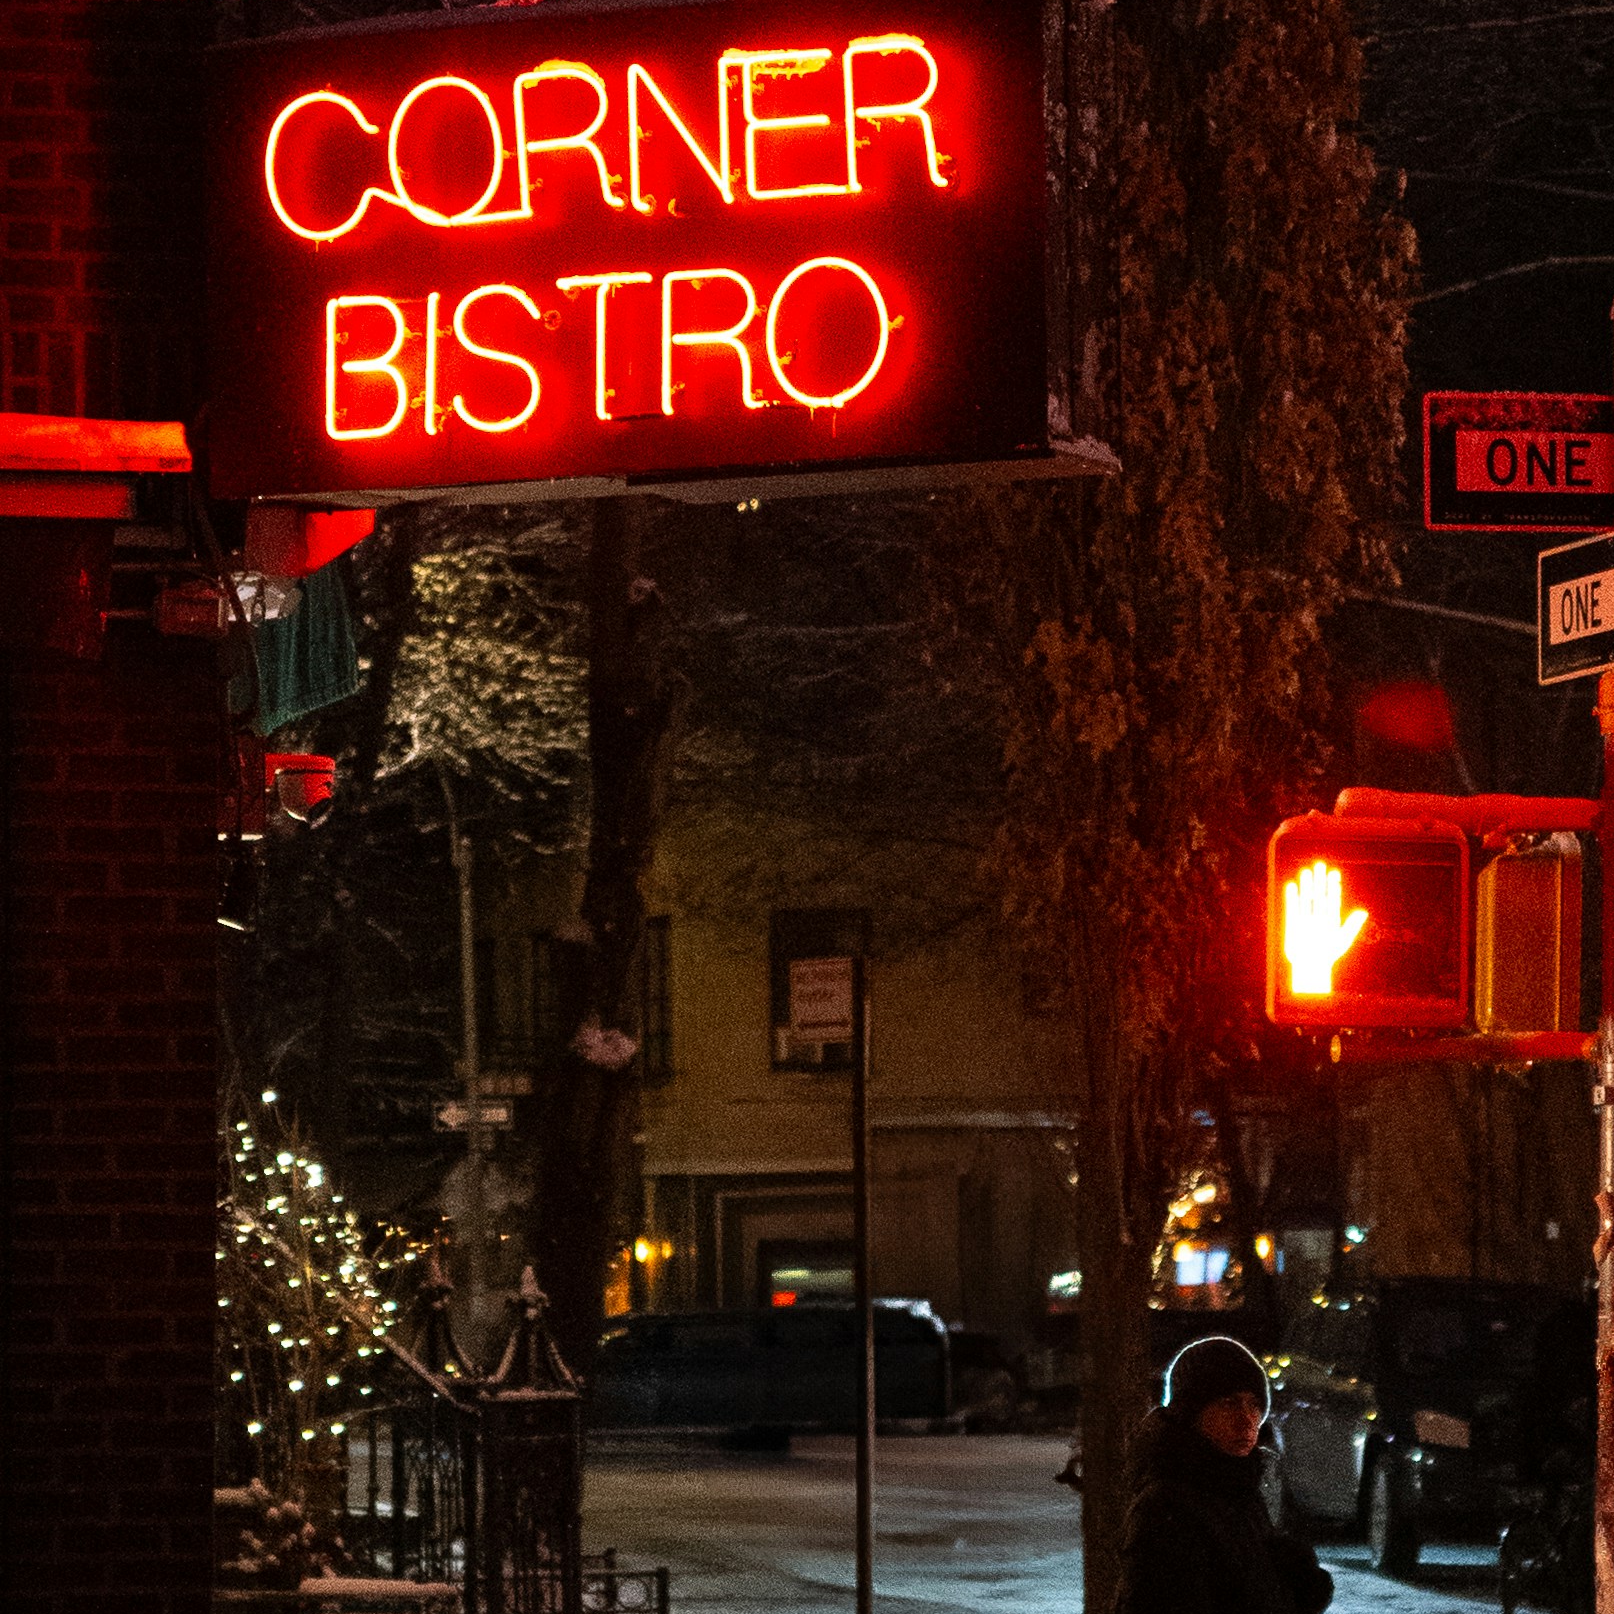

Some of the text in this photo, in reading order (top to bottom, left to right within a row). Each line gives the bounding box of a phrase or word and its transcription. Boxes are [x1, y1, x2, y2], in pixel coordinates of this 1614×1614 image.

[265, 36, 949, 241] CORNER
[326, 256, 889, 440] BISTRO
[1486, 438, 1593, 487] ONE
[1561, 580, 1601, 636] ONE
